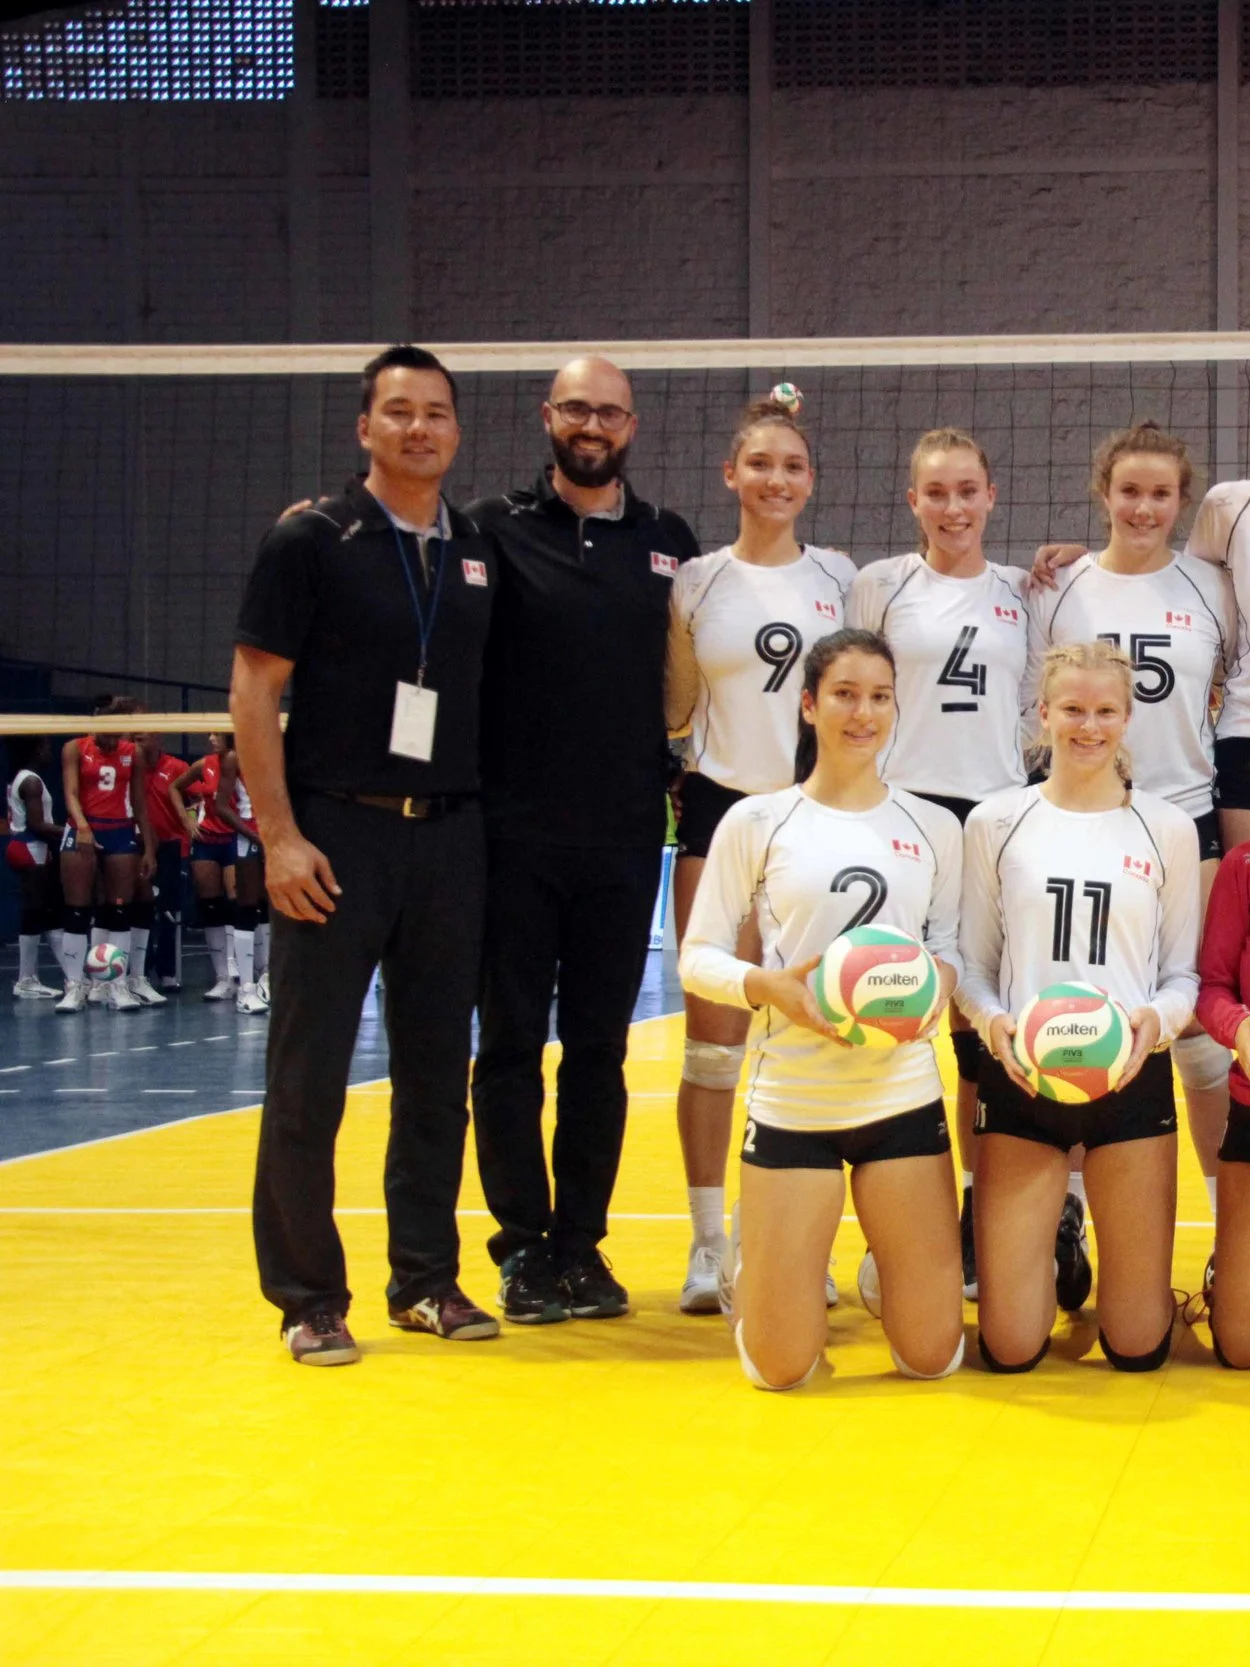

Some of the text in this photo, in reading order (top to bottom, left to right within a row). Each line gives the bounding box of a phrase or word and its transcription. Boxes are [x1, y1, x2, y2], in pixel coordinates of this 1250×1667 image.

[755, 622, 803, 692] 9
[937, 625, 986, 696] 4
[98, 766, 116, 791] 3
[830, 865, 888, 938] 2
[1046, 877, 1112, 966] 11
[867, 973, 919, 986] molten
[1046, 1023, 1098, 1036] molten
[743, 1120, 757, 1152] 2
